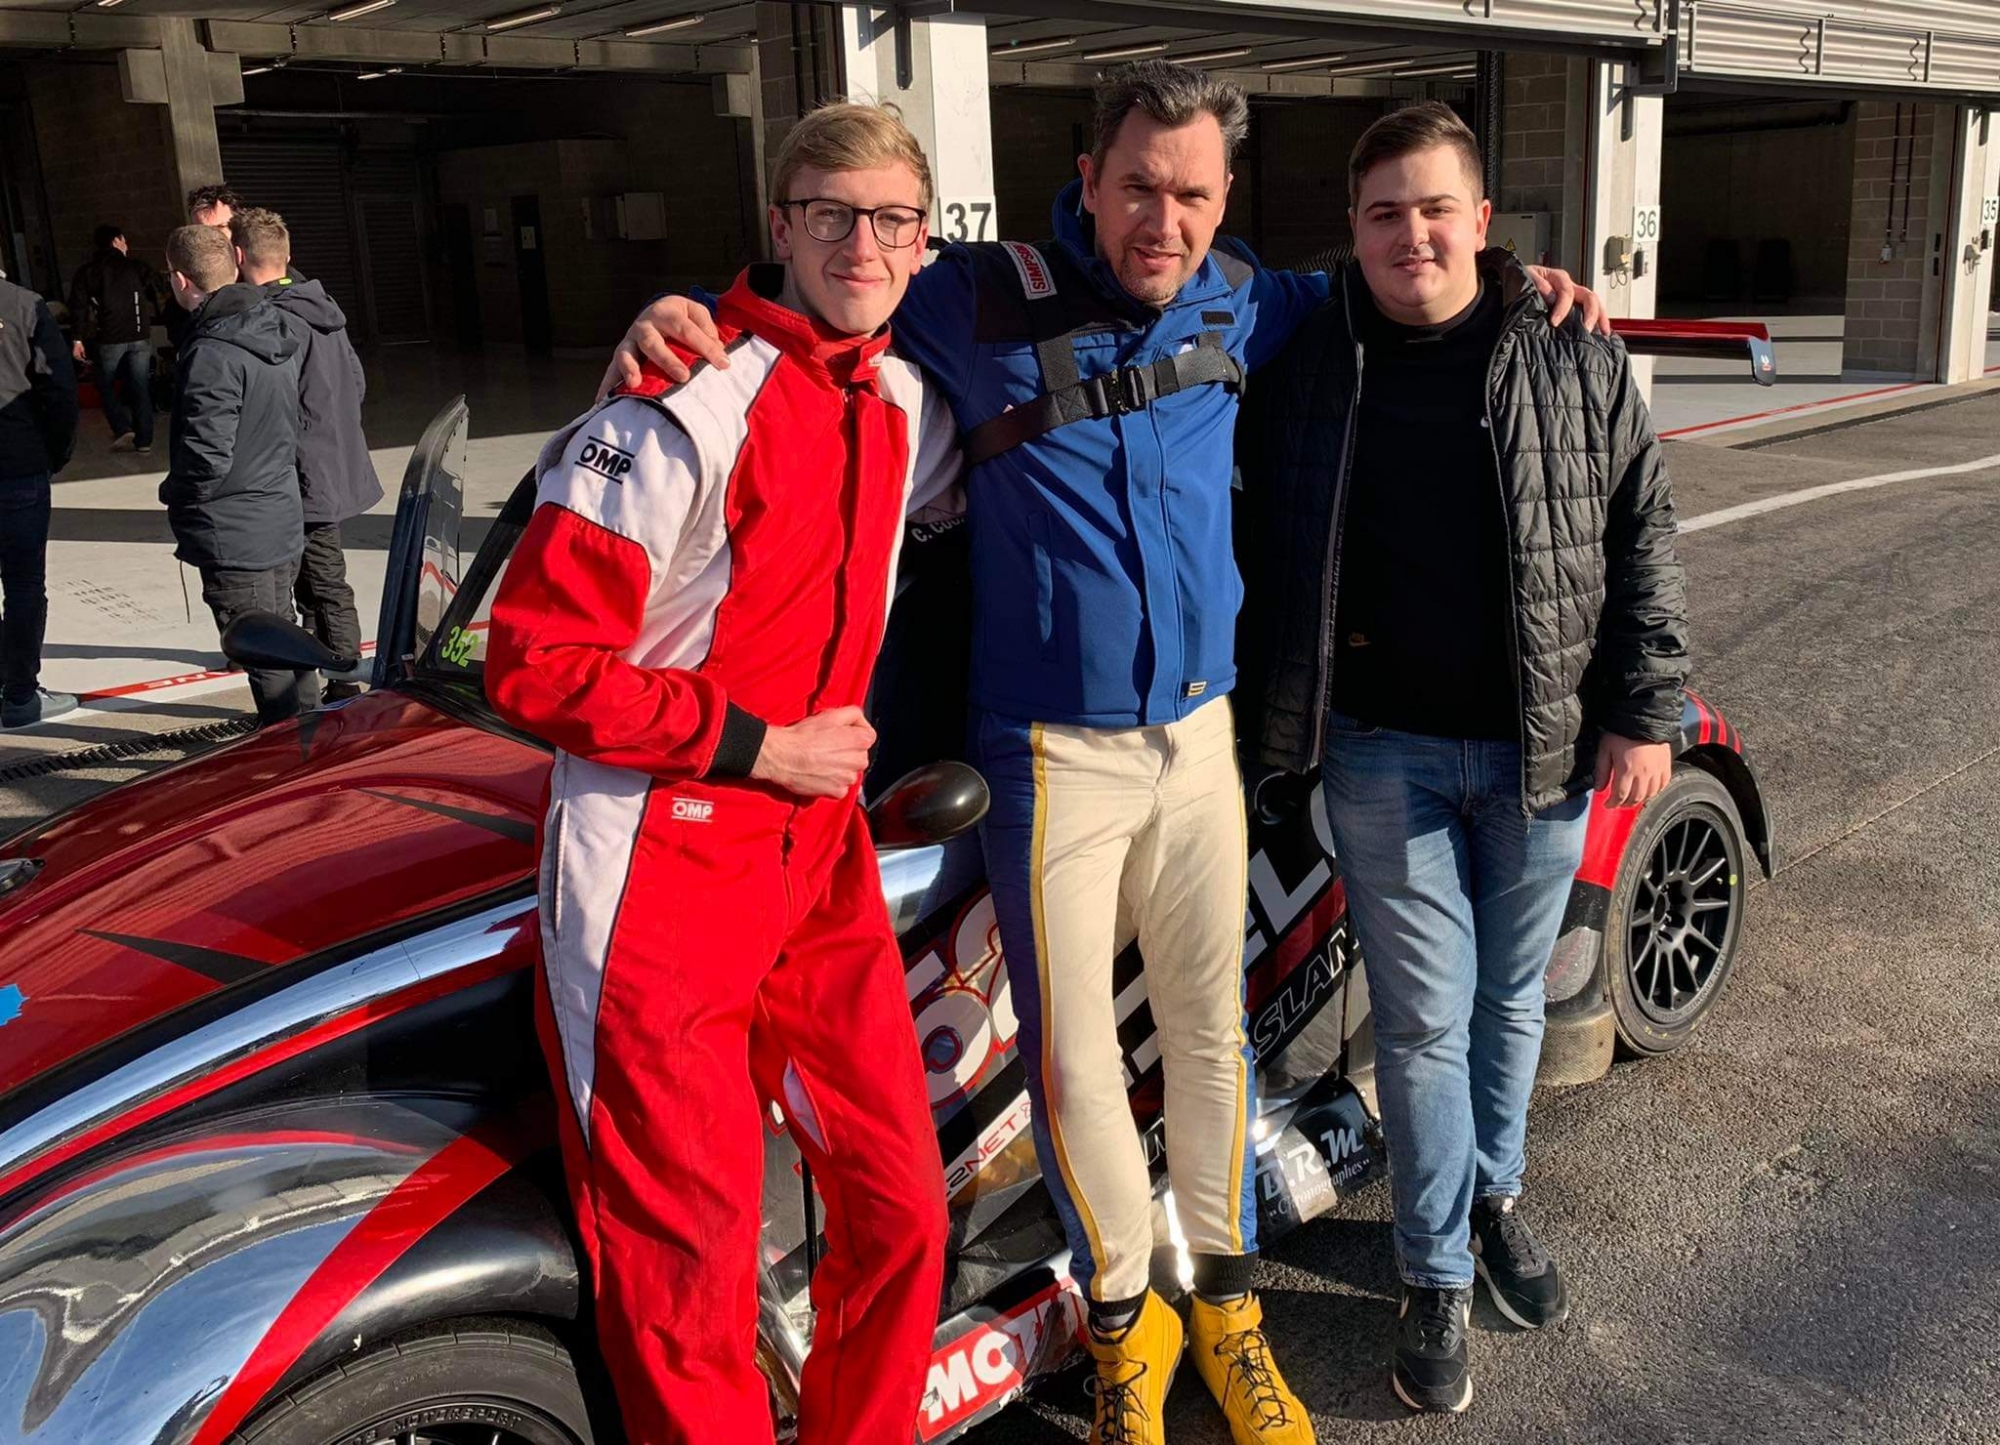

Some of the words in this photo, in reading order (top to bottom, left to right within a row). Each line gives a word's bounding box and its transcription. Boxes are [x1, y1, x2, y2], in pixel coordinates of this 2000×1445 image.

[945, 202, 992, 242] 37
[1636, 210, 1657, 238] 36
[1984, 199, 1997, 220] 35
[580, 443, 632, 477] OMP
[441, 625, 479, 668] 352
[672, 801, 713, 819] OMP
